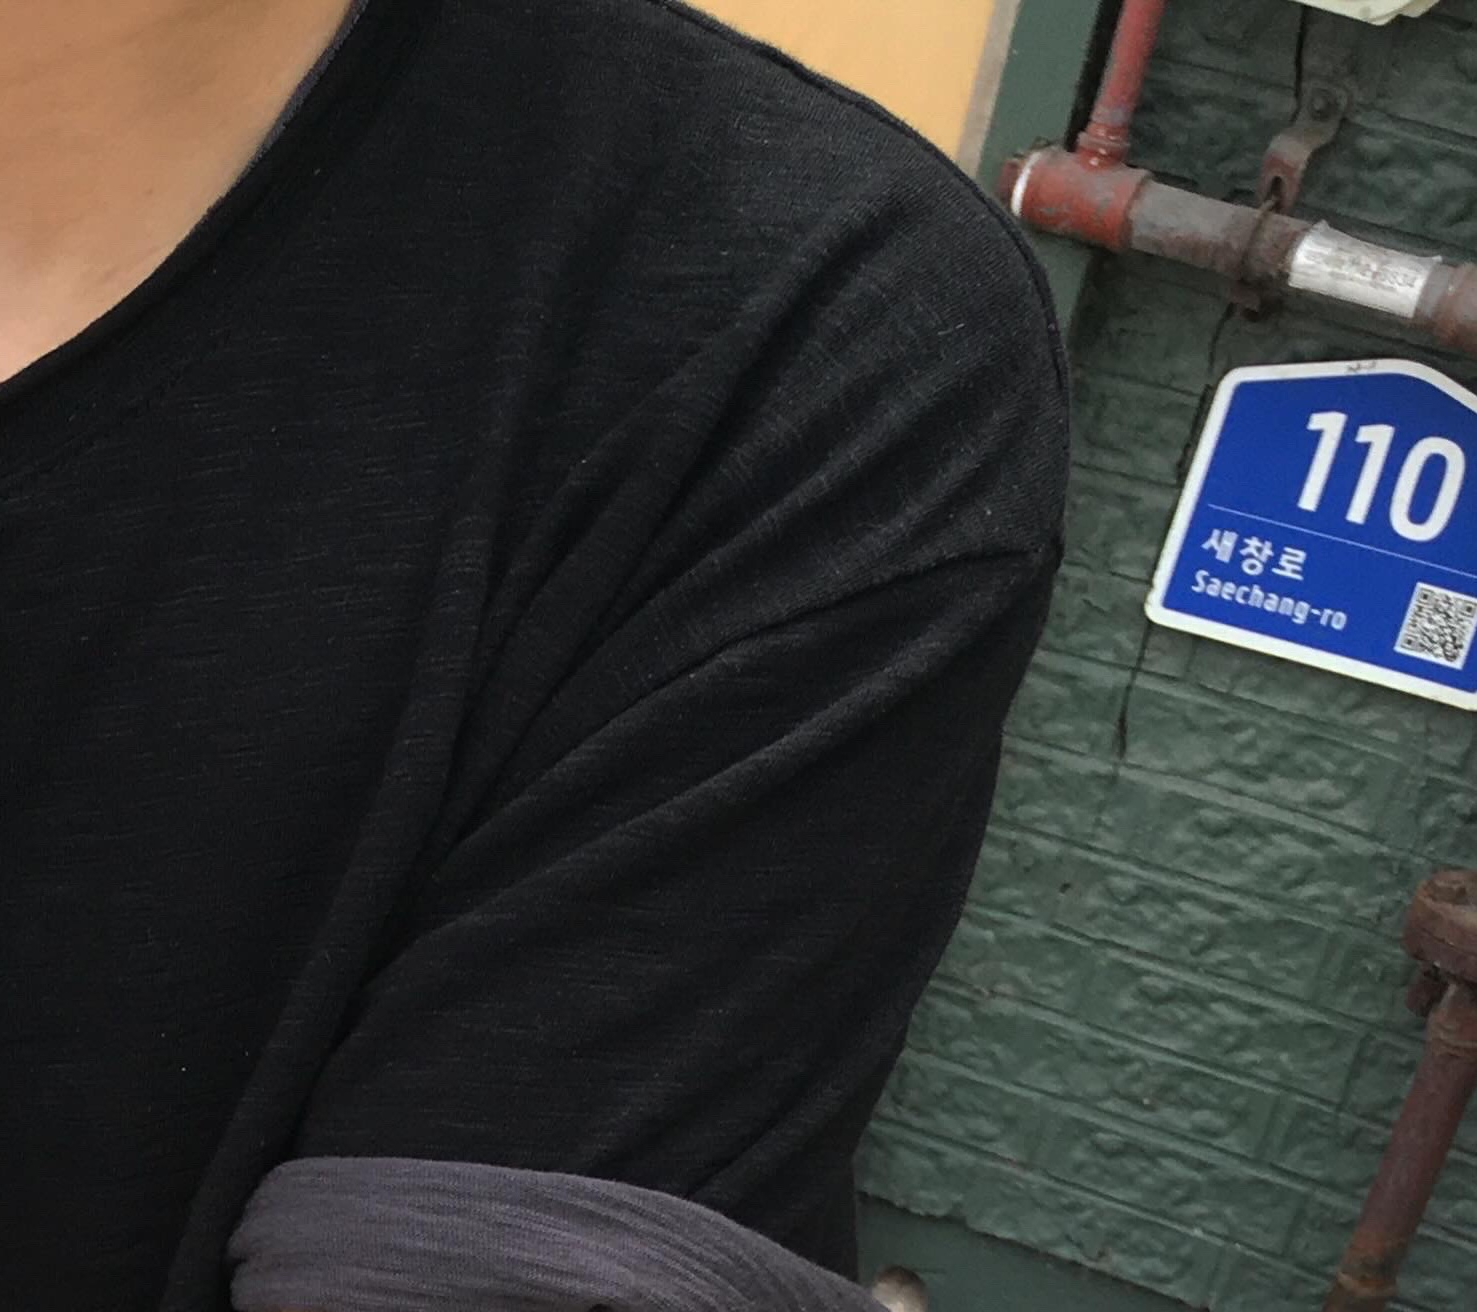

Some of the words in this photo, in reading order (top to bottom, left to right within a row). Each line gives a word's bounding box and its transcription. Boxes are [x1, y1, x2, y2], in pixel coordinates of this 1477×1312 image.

[1296, 410, 1466, 543] 110
[1202, 528, 1307, 581] 새창로
[1191, 569, 1348, 631] Saechang-ro
